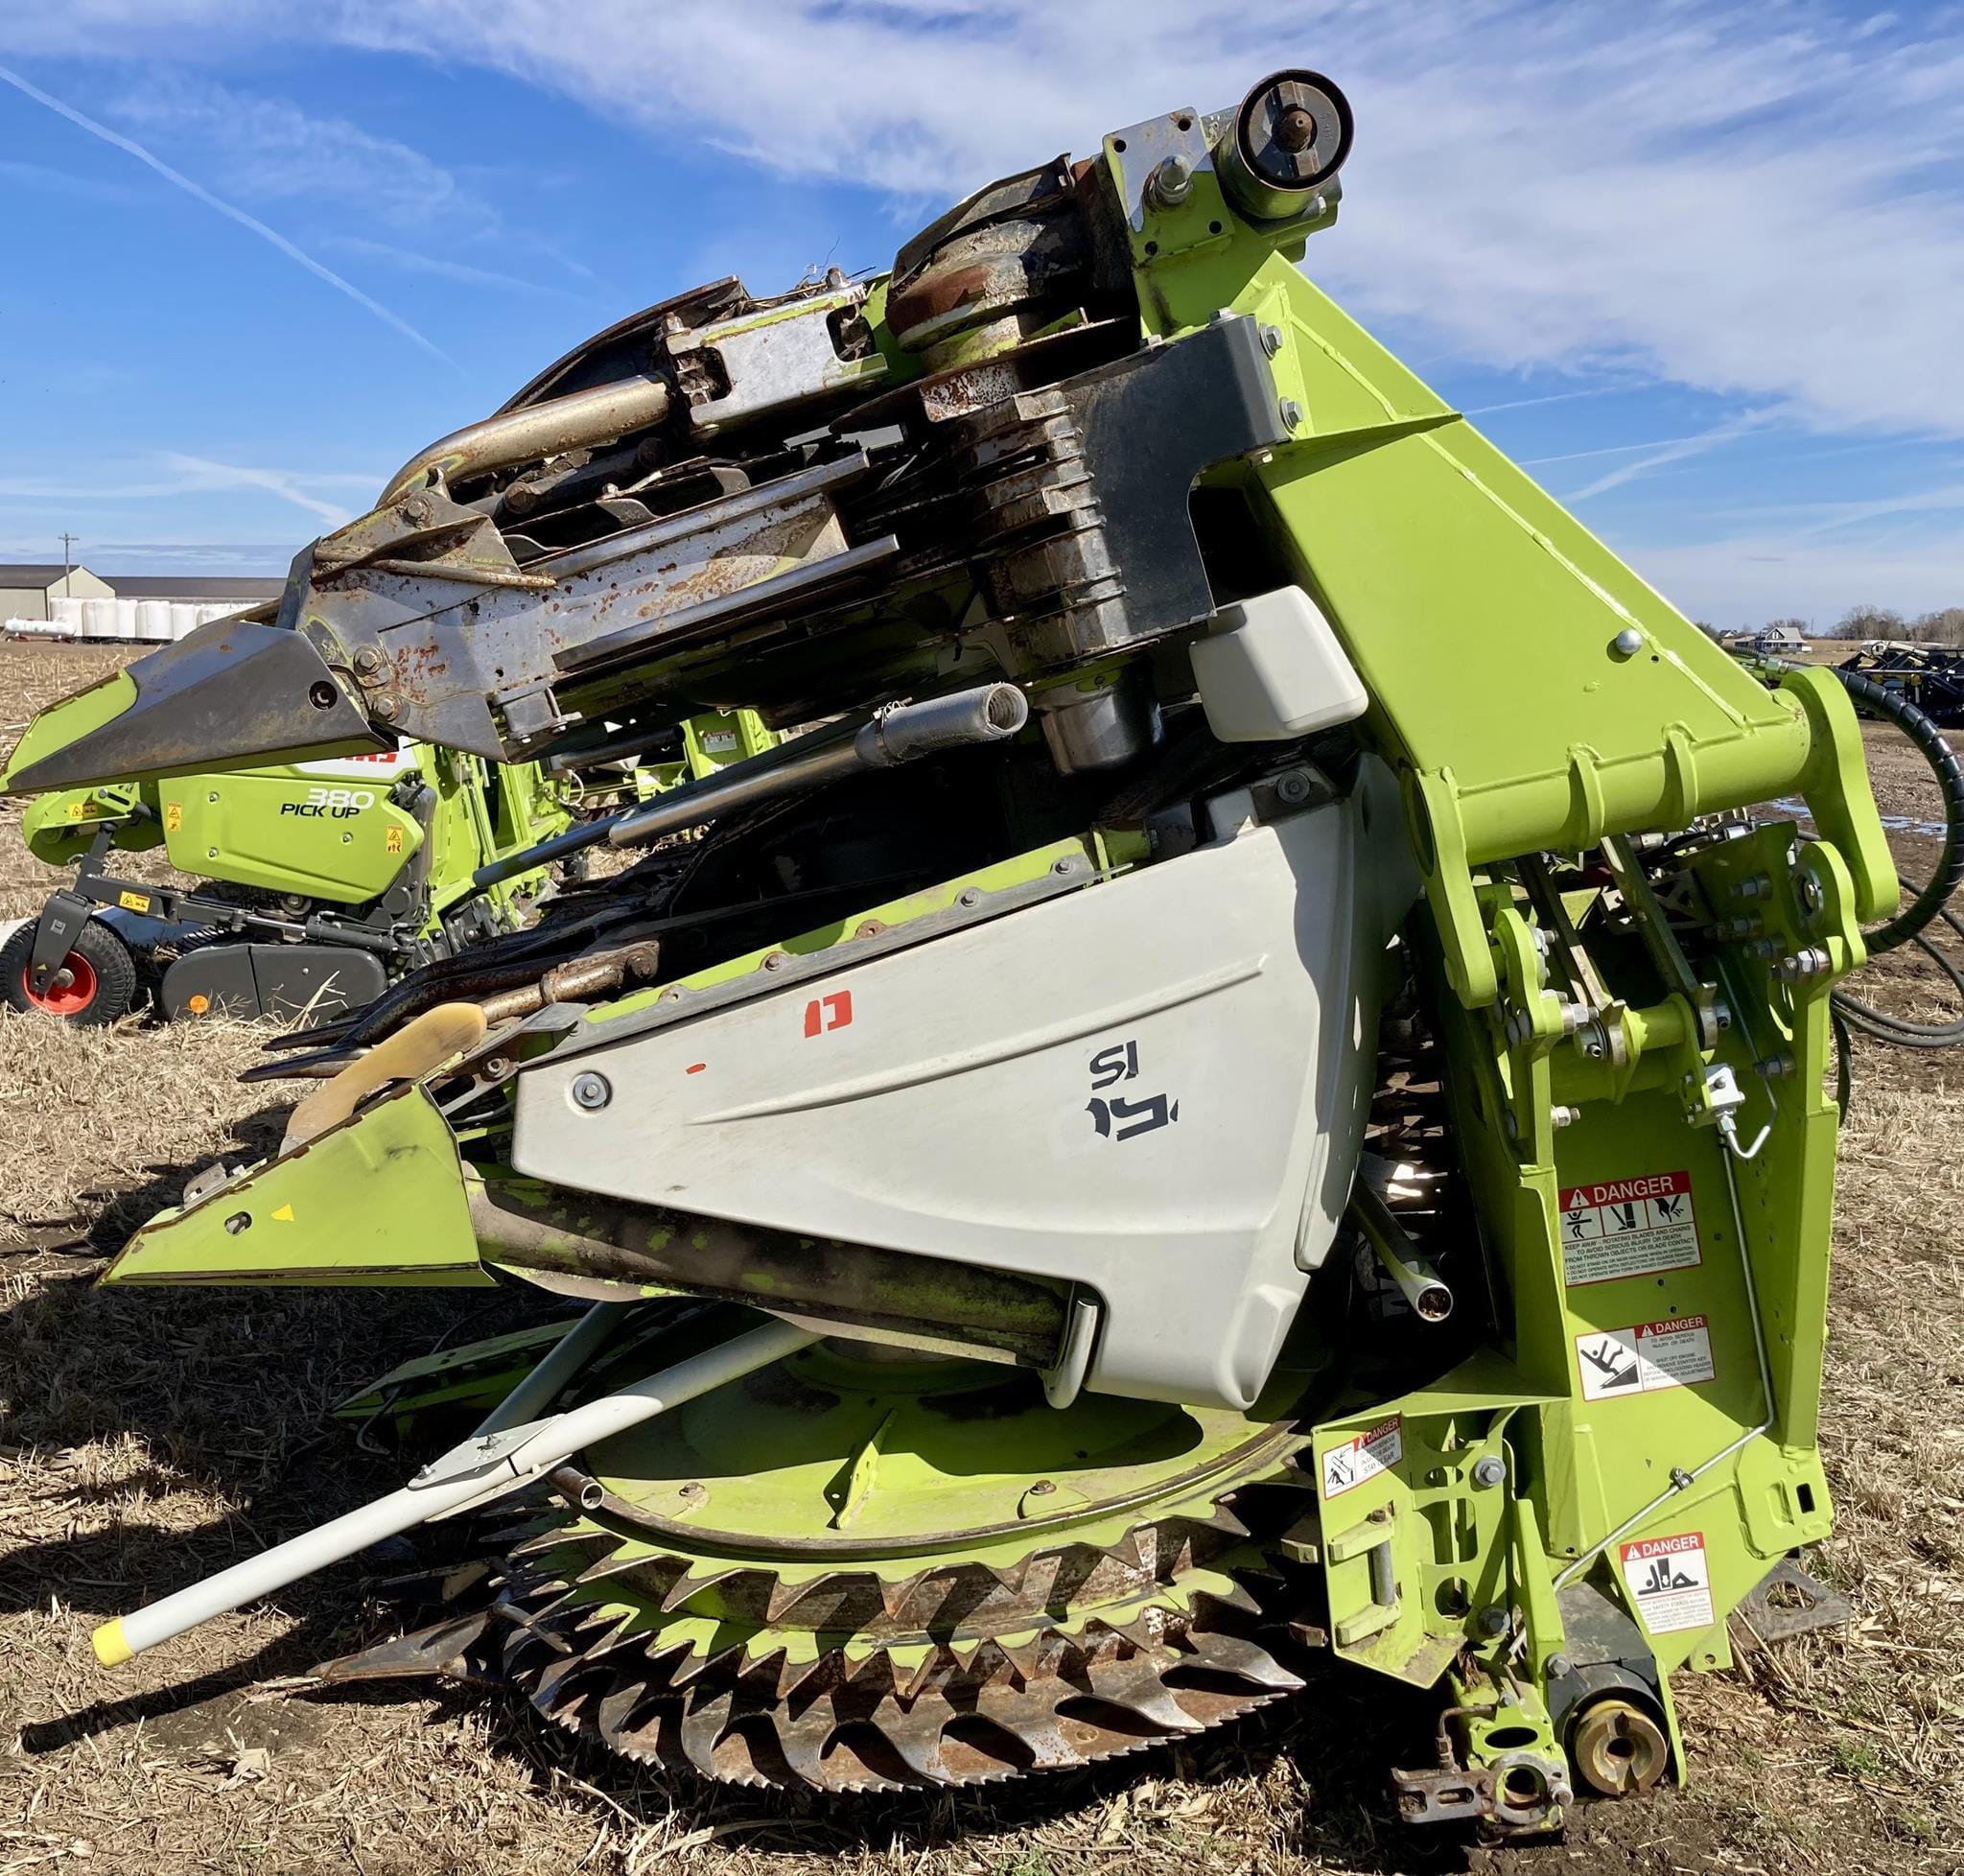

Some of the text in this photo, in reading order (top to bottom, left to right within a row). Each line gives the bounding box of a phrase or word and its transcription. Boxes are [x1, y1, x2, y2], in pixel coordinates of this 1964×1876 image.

[306, 787, 375, 809] 380
[280, 804, 361, 819] PICK UP
[1594, 1176, 1674, 1203] DANGER
[1602, 1235, 1630, 1244] ROTATING
[1669, 1225, 1691, 1233] CHAINS
[1584, 1252, 1609, 1260] THROWN
[1610, 1247, 1637, 1255] OBJECTS
[1668, 1237, 1695, 1246] CONTACT
[1604, 1242, 1630, 1251] SERIOUS
[1655, 1316, 1704, 1334] DANGER
[1366, 1418, 1398, 1442] DANGER
[1642, 1536, 1699, 1557] DANGER
